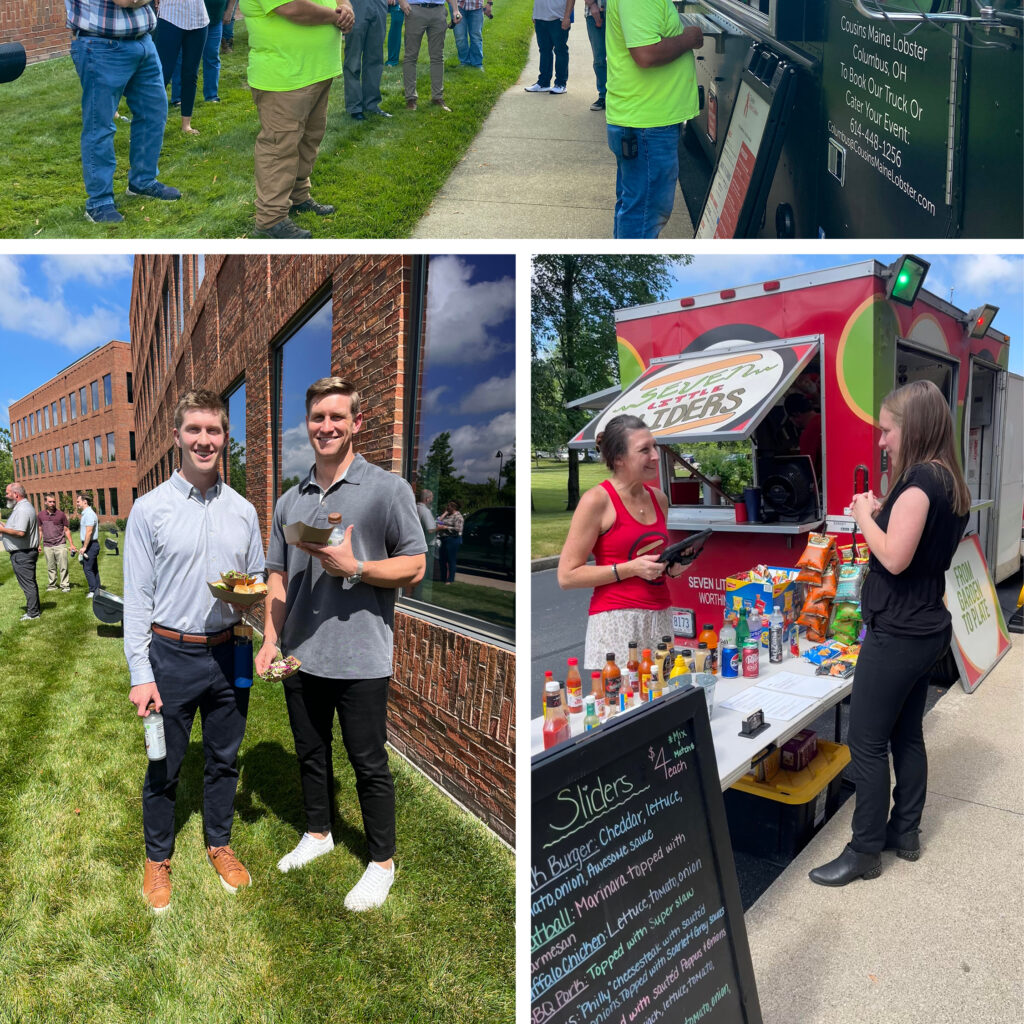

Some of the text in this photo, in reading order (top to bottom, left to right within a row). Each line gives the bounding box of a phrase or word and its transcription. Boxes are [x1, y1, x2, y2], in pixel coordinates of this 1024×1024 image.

[840, 15, 928, 62] Cousins Maine Lobster
[853, 44, 907, 83] Columbus, OH
[840, 62, 923, 121] To Book Our Truck Or
[845, 89, 911, 145] Cater Your Event:
[850, 117, 902, 168] 614-448-1256
[827, 120, 936, 217] Columbus@CousinsMaineLobster.com
[647, 384, 724, 410] LITTLE
[688, 576, 714, 589] SEVEN
[953, 560, 975, 587] FROM
[956, 578, 984, 612] GARDEN
[673, 616, 690, 629] 8173
[961, 598, 991, 635] TO PLATE
[667, 760, 688, 778] each
[549, 775, 633, 830] Sliders
[599, 810, 647, 846] Cheddar,
[645, 789, 683, 817] lettuce,
[629, 829, 654, 852] sauce
[574, 874, 628, 918] Marinara
[626, 848, 664, 880] topped
[665, 833, 686, 854] with
[606, 898, 652, 938] Lettuce,
[678, 858, 702, 886] onion
[586, 942, 625, 979] Topped
[626, 926, 648, 950] with
[648, 903, 674, 930] Super
[675, 888, 694, 909] slaw
[662, 926, 681, 947] with
[619, 956, 666, 1002] Topped with
[628, 995, 651, 1021] with
